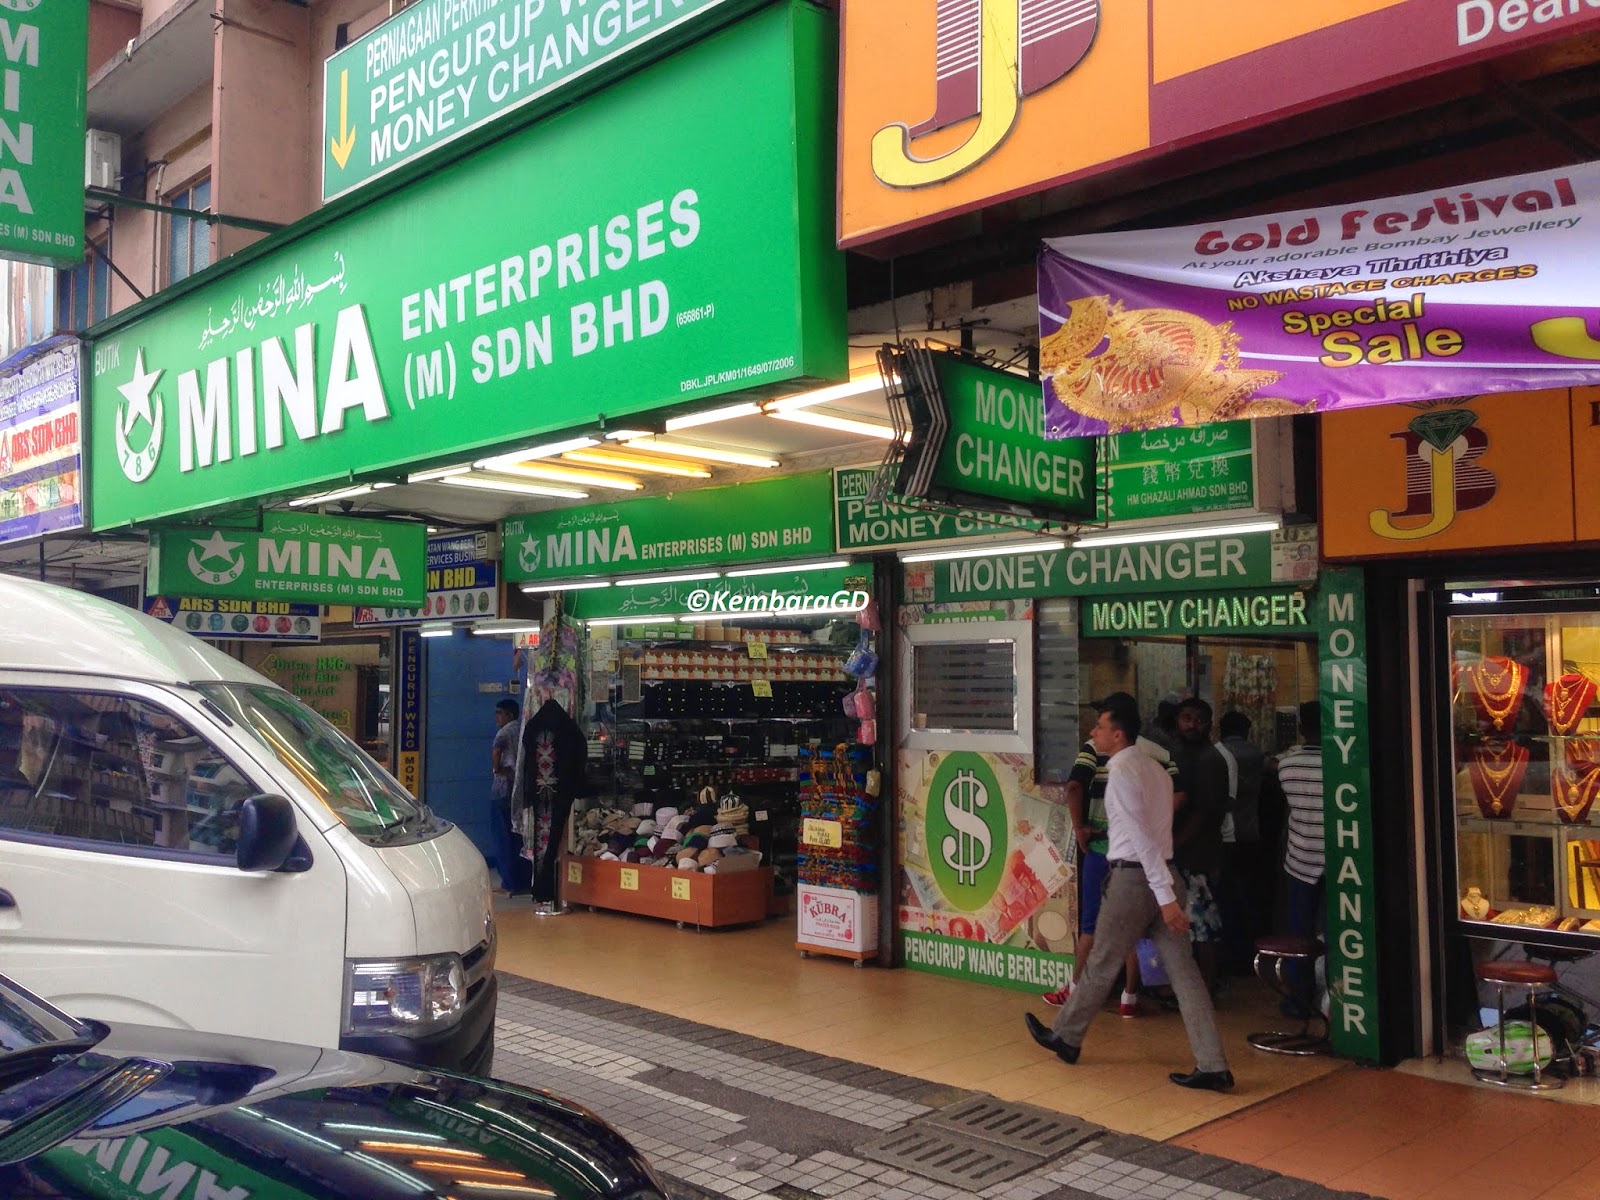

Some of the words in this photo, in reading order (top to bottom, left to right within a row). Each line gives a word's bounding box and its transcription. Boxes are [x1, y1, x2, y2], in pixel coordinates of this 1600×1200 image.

[366, 0, 441, 83] PERNIAGAAN
[370, 0, 546, 124] PENGURUP
[370, 75, 479, 167] MONEY
[13, 224, 29, 240] (M)
[32, 229, 52, 243] SDN
[55, 232, 76, 247] BHD
[1182, 260, 1208, 270] At
[1209, 257, 1260, 270] your
[1262, 245, 1359, 265] adorable
[1364, 233, 1460, 253] Bombay
[1463, 216, 1583, 241] Jewellery
[1194, 217, 1321, 256] Gold
[401, 188, 701, 341] ENTERPRISES
[1233, 264, 1360, 289] Akshaya
[1365, 246, 1509, 276] Thrithiya
[1227, 295, 1260, 312] NO
[1261, 277, 1387, 307] WASTAGE
[1391, 263, 1540, 290] CHARGES
[676, 302, 715, 329] (656861-P)
[1282, 293, 1426, 337] Special
[95, 341, 120, 377] BUTIK
[403, 341, 457, 411] (M)
[470, 314, 553, 384] SDN
[570, 279, 671, 359] BHD
[1319, 322, 1465, 369] Sale
[177, 303, 392, 474] MINA
[32, 421, 54, 455] SDN
[55, 412, 78, 448] BHD
[956, 432, 1085, 500] CHANGER
[1127, 493, 1139, 506] HM
[1140, 489, 1176, 505] GHAZALI
[1176, 486, 1207, 501] AHMAD
[1208, 483, 1228, 497] SDN
[1228, 480, 1249, 495] BHD
[505, 520, 525, 536] BUTIK
[546, 525, 638, 569] MINA
[641, 535, 723, 560] ENTERPRISES
[727, 531, 747, 553] (M)
[750, 530, 778, 549] SDN
[782, 526, 812, 546] BHD
[849, 514, 945, 543] MONEY
[258, 537, 401, 581] MINA
[443, 566, 476, 588] BHD
[949, 552, 1056, 594] MONEY
[1066, 538, 1247, 586] CHANGER
[255, 579, 334, 593] ENTERPRISES
[337, 582, 354, 594] (M)
[357, 585, 379, 596] SDN
[382, 587, 404, 597] BHD
[1092, 599, 1174, 631] MONEY
[1179, 593, 1308, 629] CHANGER
[406, 637, 417, 708] PENGURUP
[1328, 592, 1357, 765] MONEY
[405, 712, 417, 749] WANG
[1335, 783, 1368, 1036] CHANGER
[904, 936, 966, 971] PENGURUP
[968, 948, 1005, 979] WANG
[1007, 953, 1074, 988] BERLESEN
